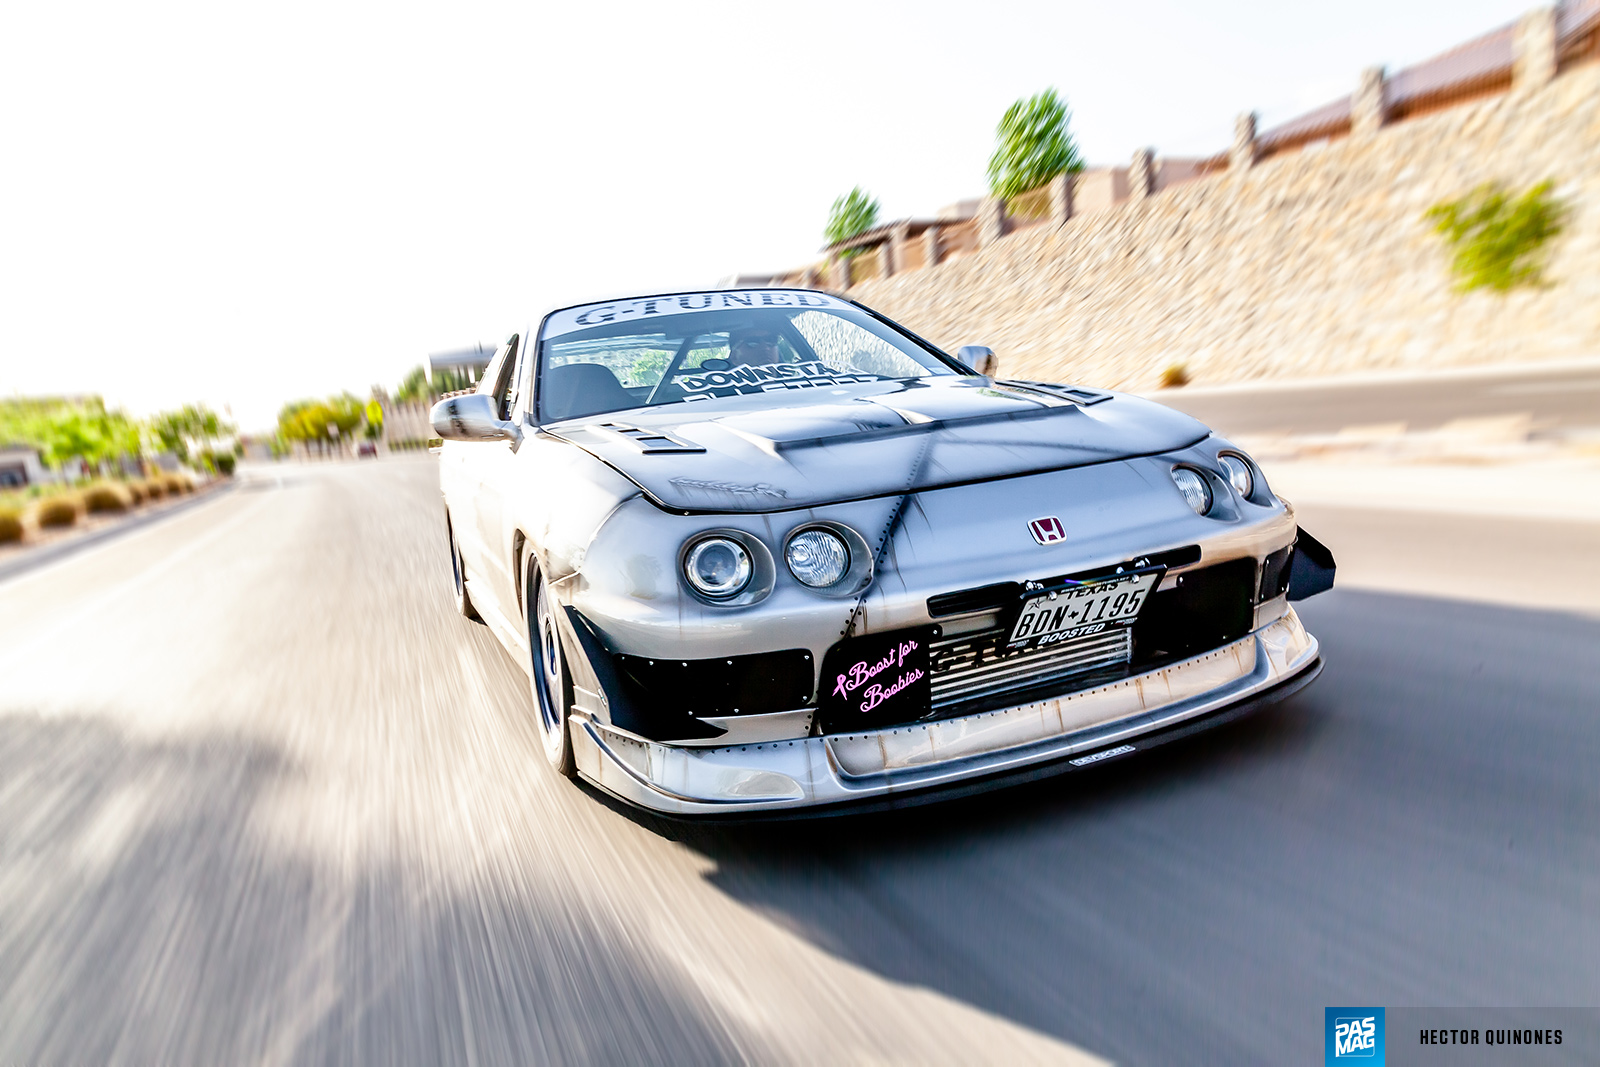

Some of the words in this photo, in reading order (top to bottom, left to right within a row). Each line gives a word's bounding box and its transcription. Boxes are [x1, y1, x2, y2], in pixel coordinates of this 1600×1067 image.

[575, 293, 831, 326] G-TUNED
[678, 360, 868, 392] DOWNSTA
[1067, 582, 1118, 600] TEXAS
[1037, 623, 1106, 646] BOOSTED
[845, 648, 896, 691] Boost
[898, 640, 918, 667] for
[860, 668, 924, 712] Boobies
